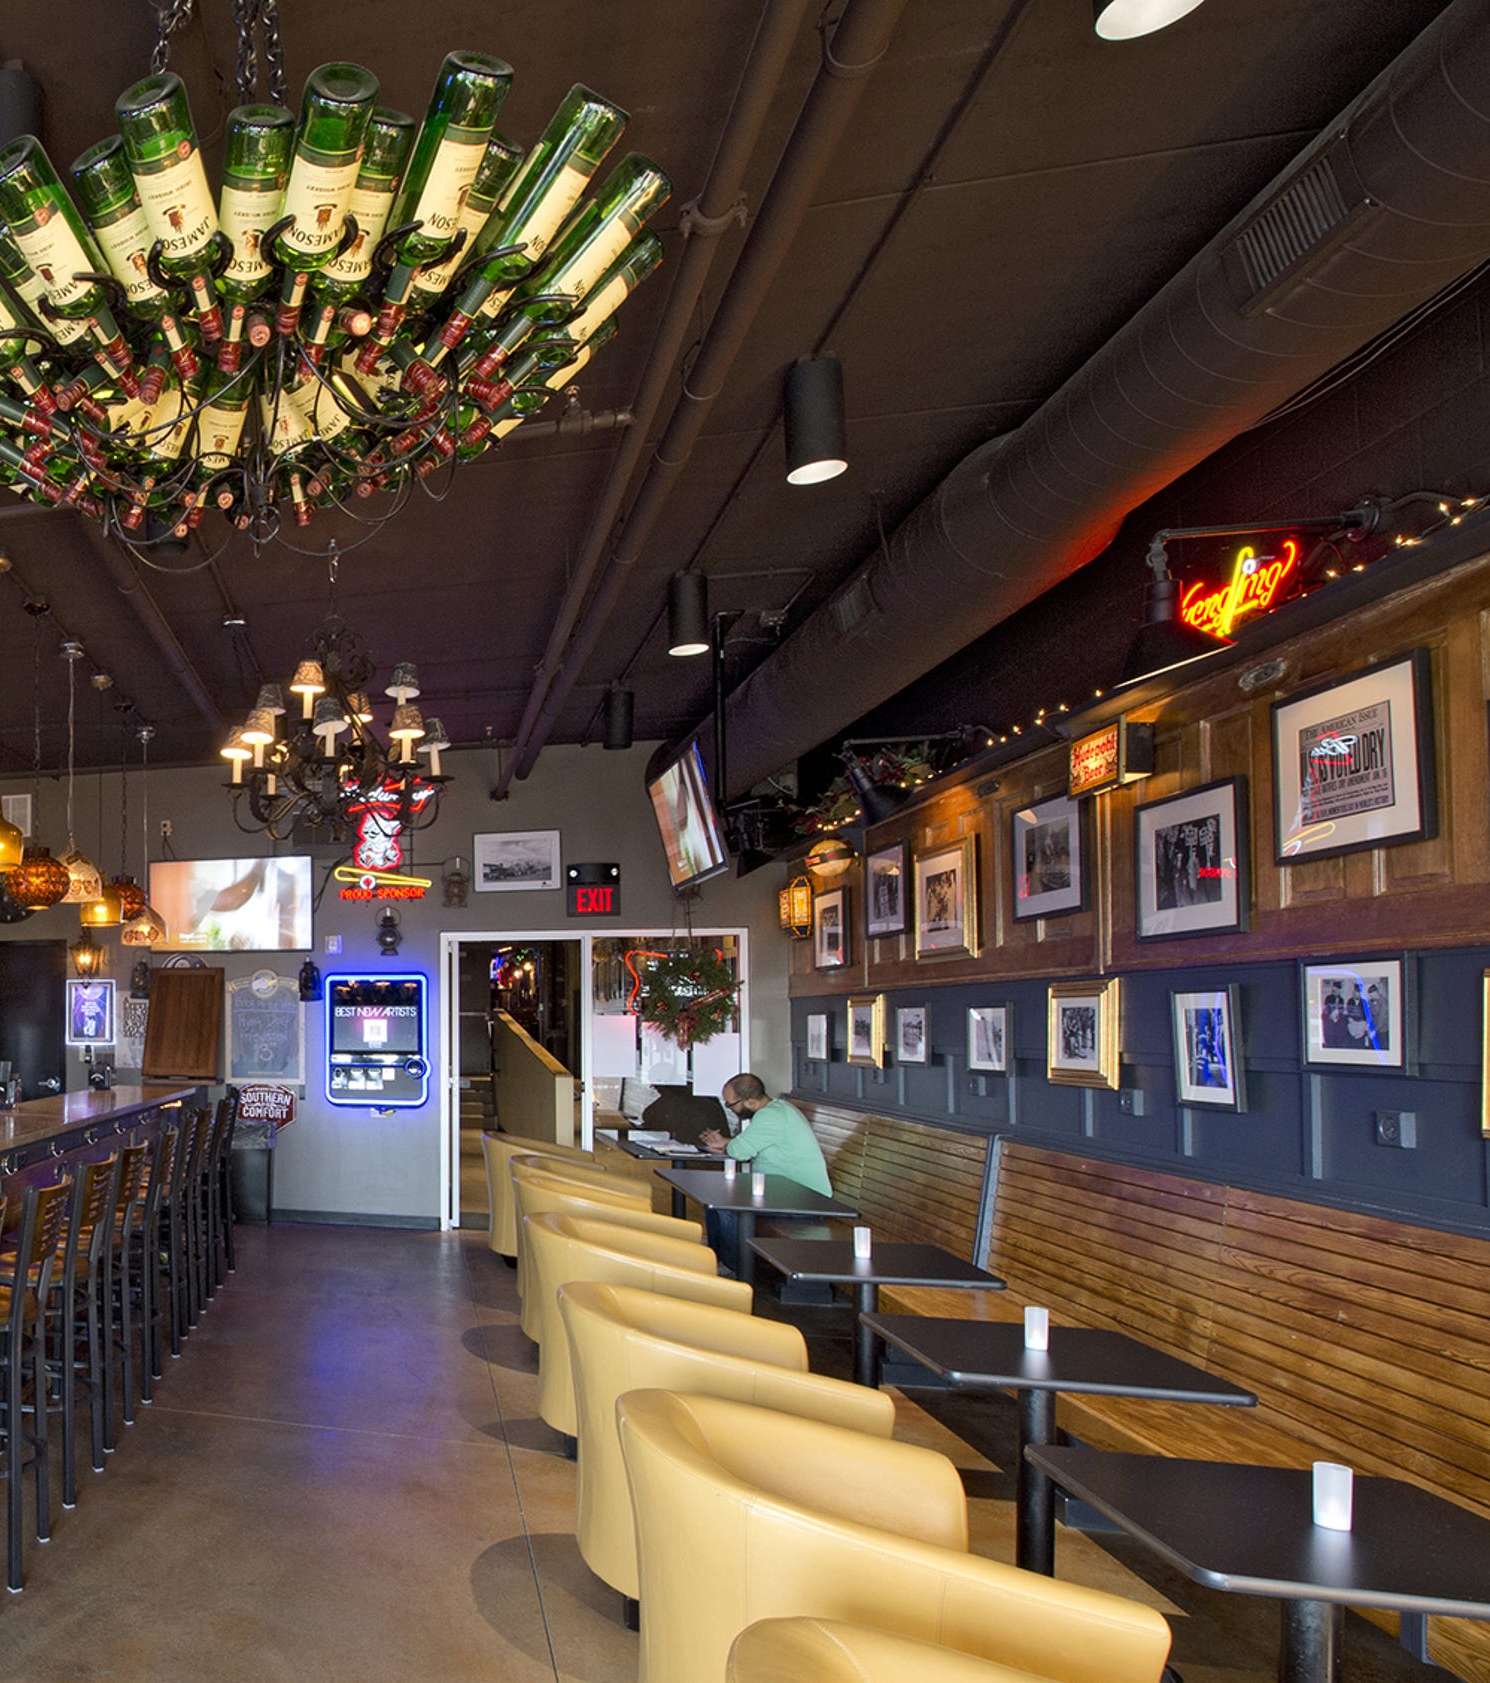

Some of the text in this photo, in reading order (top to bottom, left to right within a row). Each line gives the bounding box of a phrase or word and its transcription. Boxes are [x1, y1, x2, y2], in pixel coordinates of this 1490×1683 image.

[1362, 727, 1386, 772] DRY
[339, 886, 425, 901] PROUD SPONSOR
[576, 888, 613, 912] EXIT
[334, 1007, 417, 1017] BEST NEW ARTISTS
[240, 1091, 292, 1106] SOUTHERN
[242, 1106, 288, 1119] COMFORT
